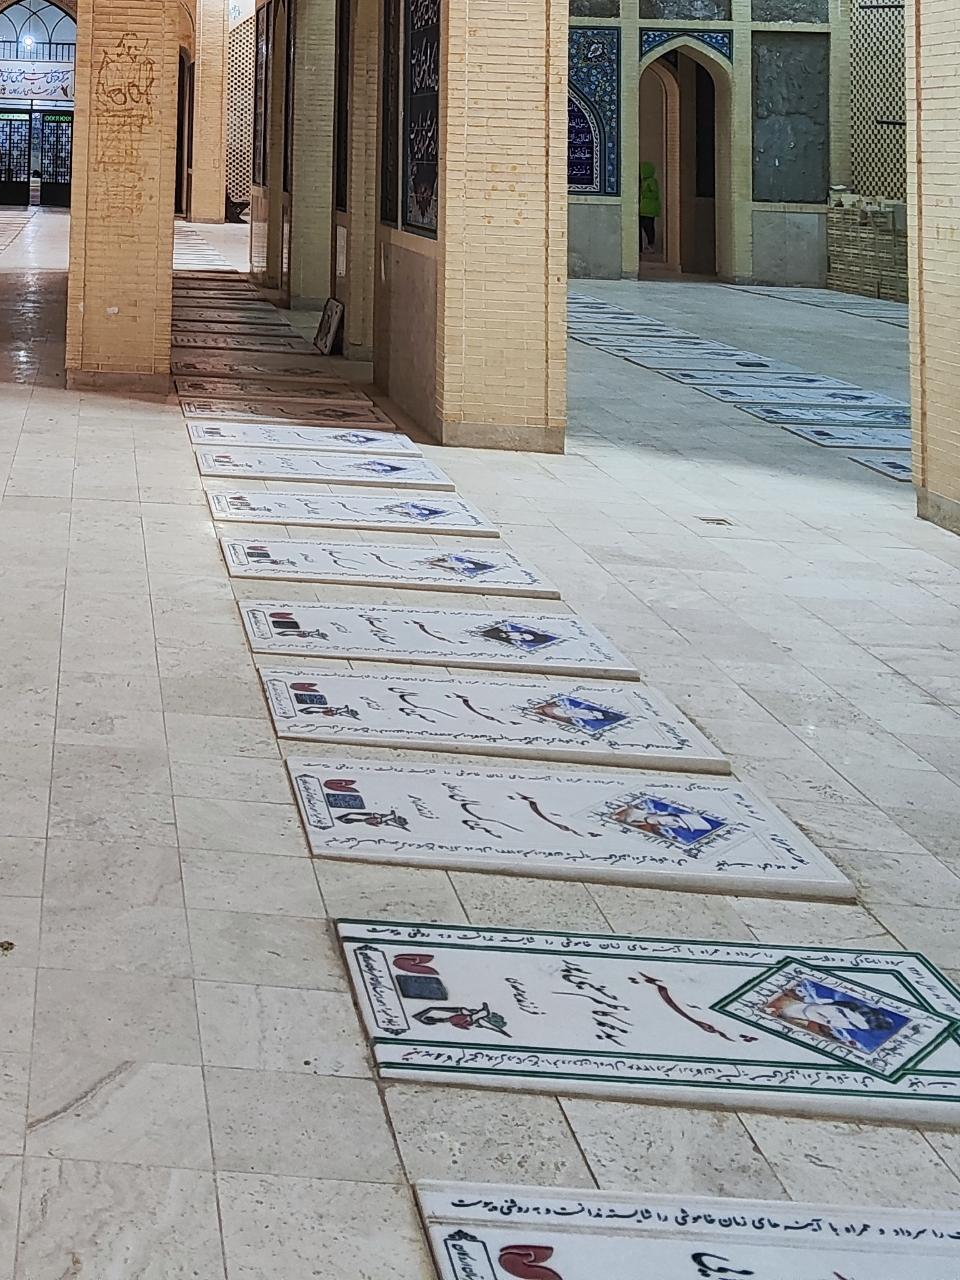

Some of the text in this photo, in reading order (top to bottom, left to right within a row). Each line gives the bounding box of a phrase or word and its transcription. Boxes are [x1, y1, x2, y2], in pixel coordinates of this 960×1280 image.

[506, 791, 603, 838] شهید
[553, 958, 631, 1047] سید محمد کاظم حسینی پور
[626, 971, 759, 1043] شهید
[400, 1049, 423, 1062] شهید
[450, 1197, 945, 1240] را سرداد و همراه با آینه های زمان خاموشی را شایسته ندانست و به روشنی پیوست
